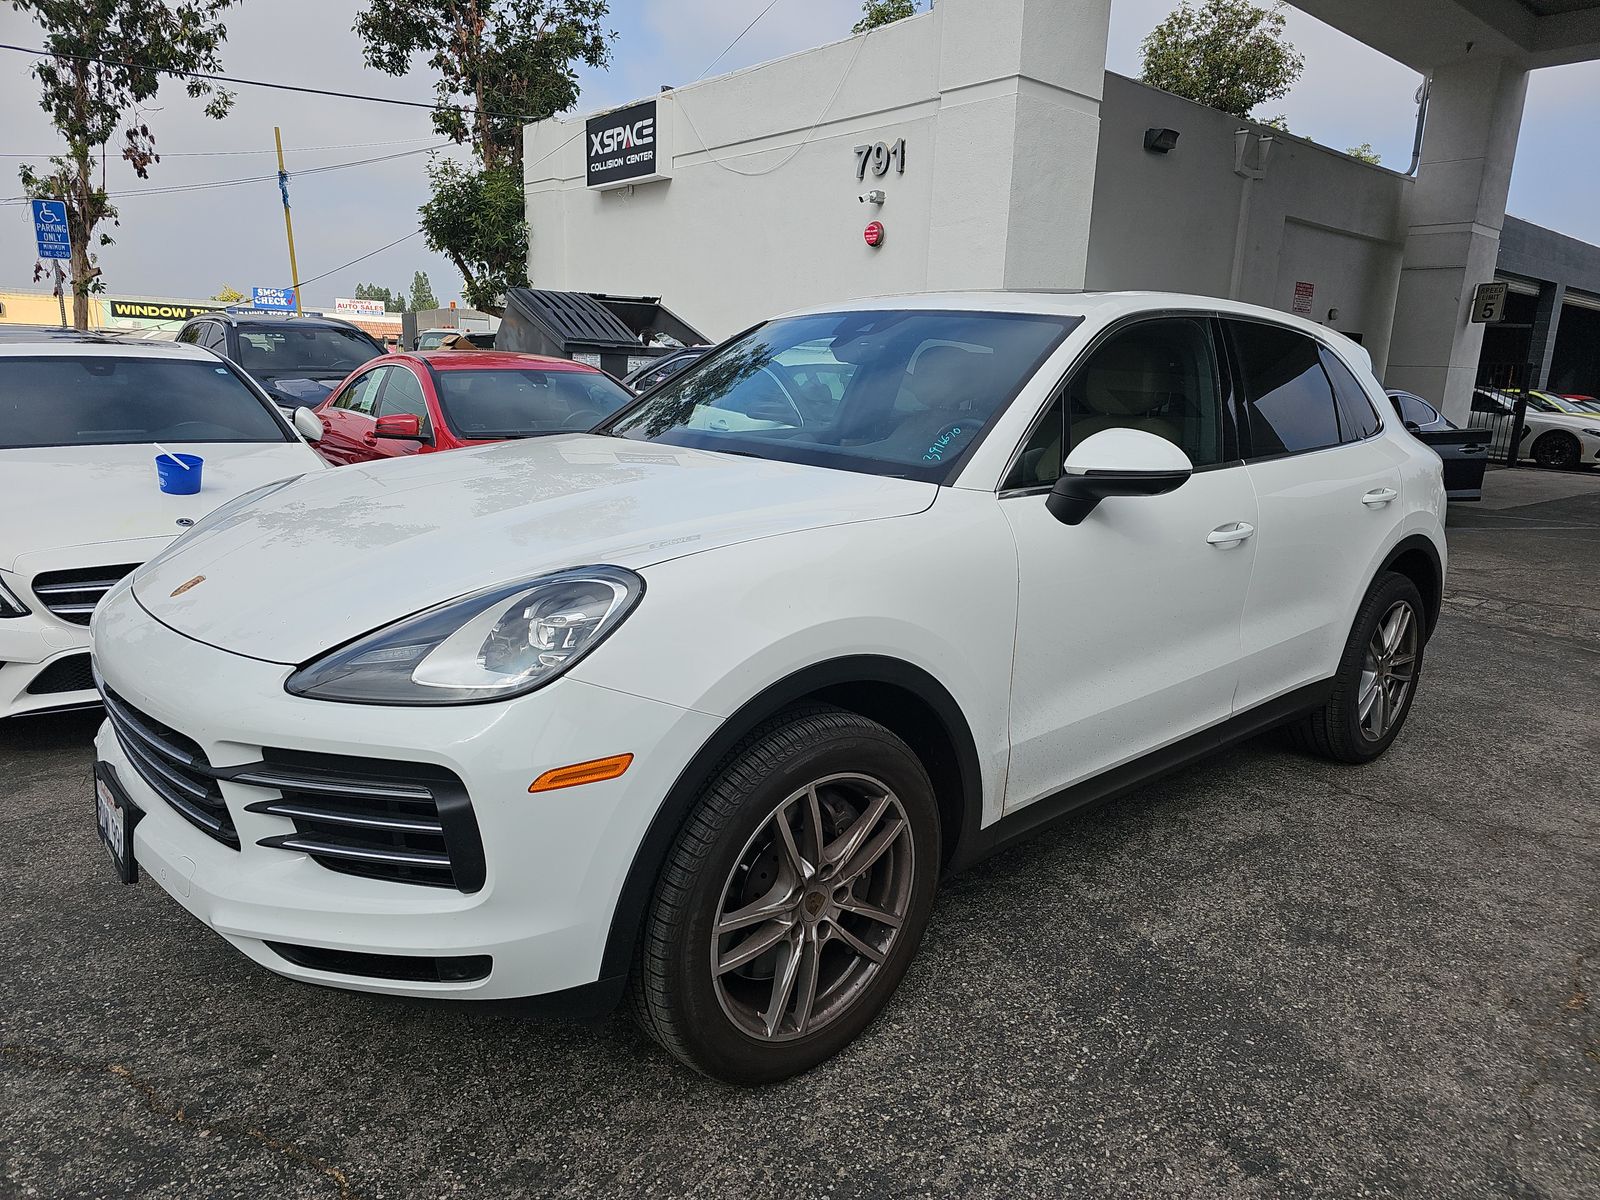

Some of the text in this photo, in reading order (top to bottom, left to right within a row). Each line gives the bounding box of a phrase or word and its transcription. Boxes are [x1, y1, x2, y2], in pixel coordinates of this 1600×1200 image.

[590, 117, 654, 157] XSPACE
[590, 150, 653, 172] COLLISION CENTER
[854, 137, 905, 181] 791
[36, 222, 67, 233] PARKING
[43, 233, 62, 242] ONLY
[254, 296, 288, 306] CHECK
[115, 303, 187, 318] WINDOW
[1481, 302, 1496, 319] 5
